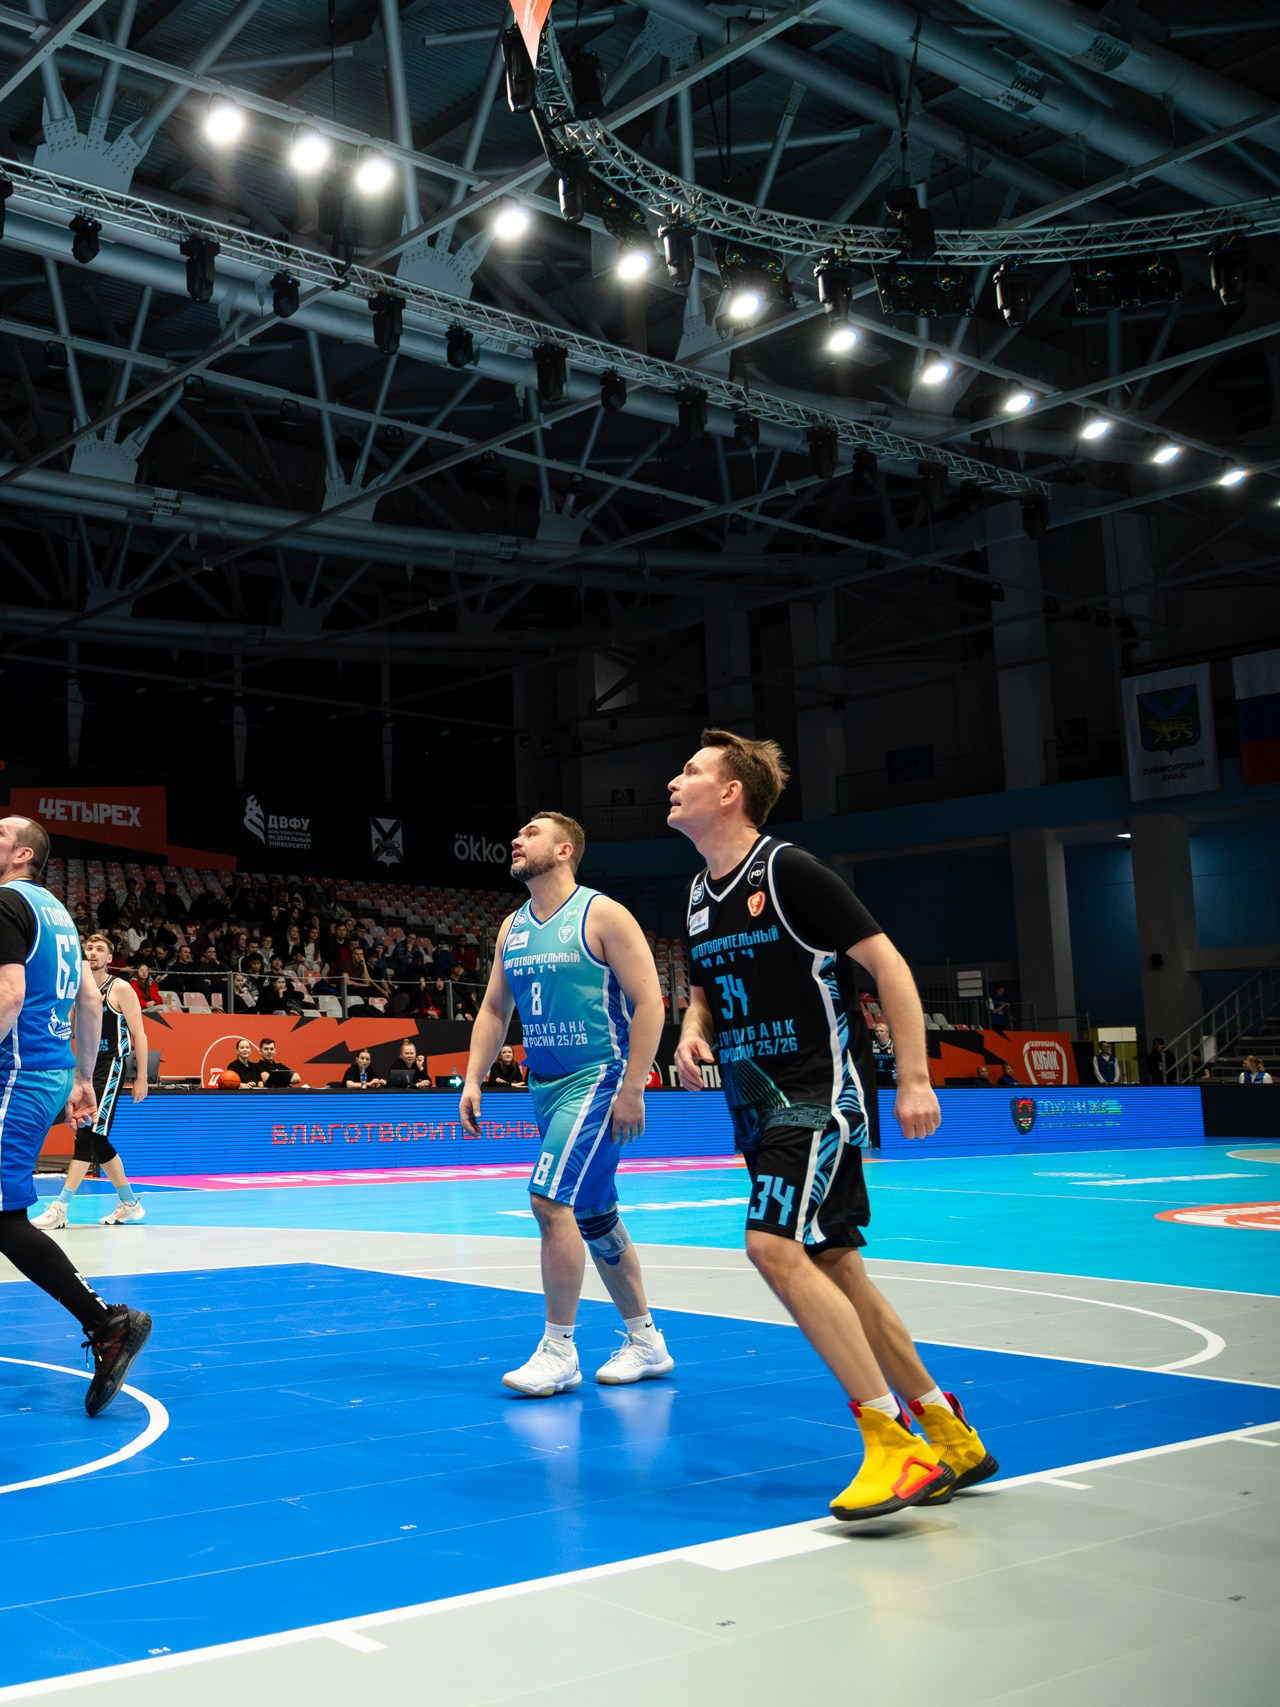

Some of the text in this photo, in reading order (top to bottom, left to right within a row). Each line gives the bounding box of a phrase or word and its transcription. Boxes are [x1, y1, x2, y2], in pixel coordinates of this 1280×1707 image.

[38, 797, 142, 828] ЧЕТЫРЕХ
[267, 815, 310, 831] ДВФУ
[55, 933, 82, 1000] 63
[513, 964, 557, 977] МАТЧ
[531, 981, 543, 1016] 8
[715, 973, 749, 1020] 34
[556, 1033, 589, 1046] 25/26
[756, 1037, 799, 1056] 25/26
[1031, 1050, 1060, 1070] КУБОК
[532, 1151, 555, 1187] 8
[748, 1174, 795, 1226] 34
